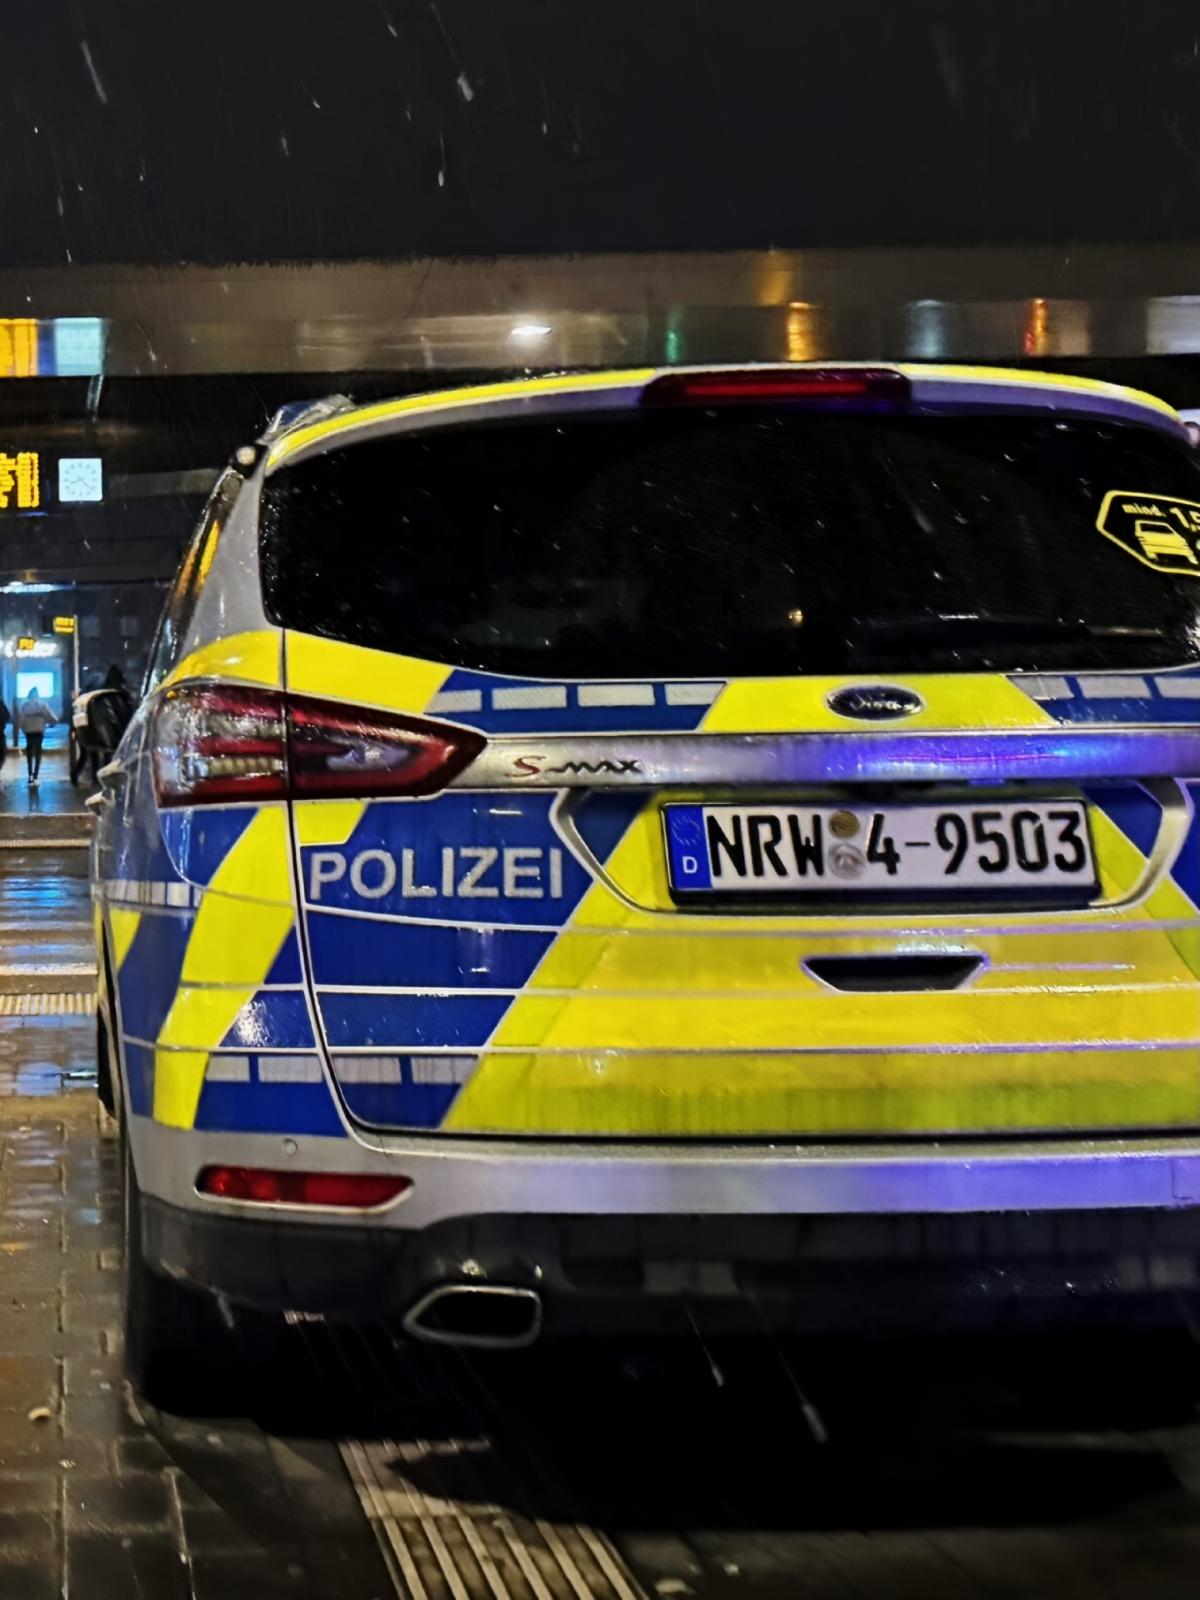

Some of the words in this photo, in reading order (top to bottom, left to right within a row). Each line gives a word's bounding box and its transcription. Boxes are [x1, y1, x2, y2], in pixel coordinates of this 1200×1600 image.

[1121, 503, 1167, 517] mind.
[682, 855, 698, 874] D
[706, 814, 824, 877] NRW
[866, 810, 1087, 876] 4-9503
[309, 846, 563, 901] POLIZEI
